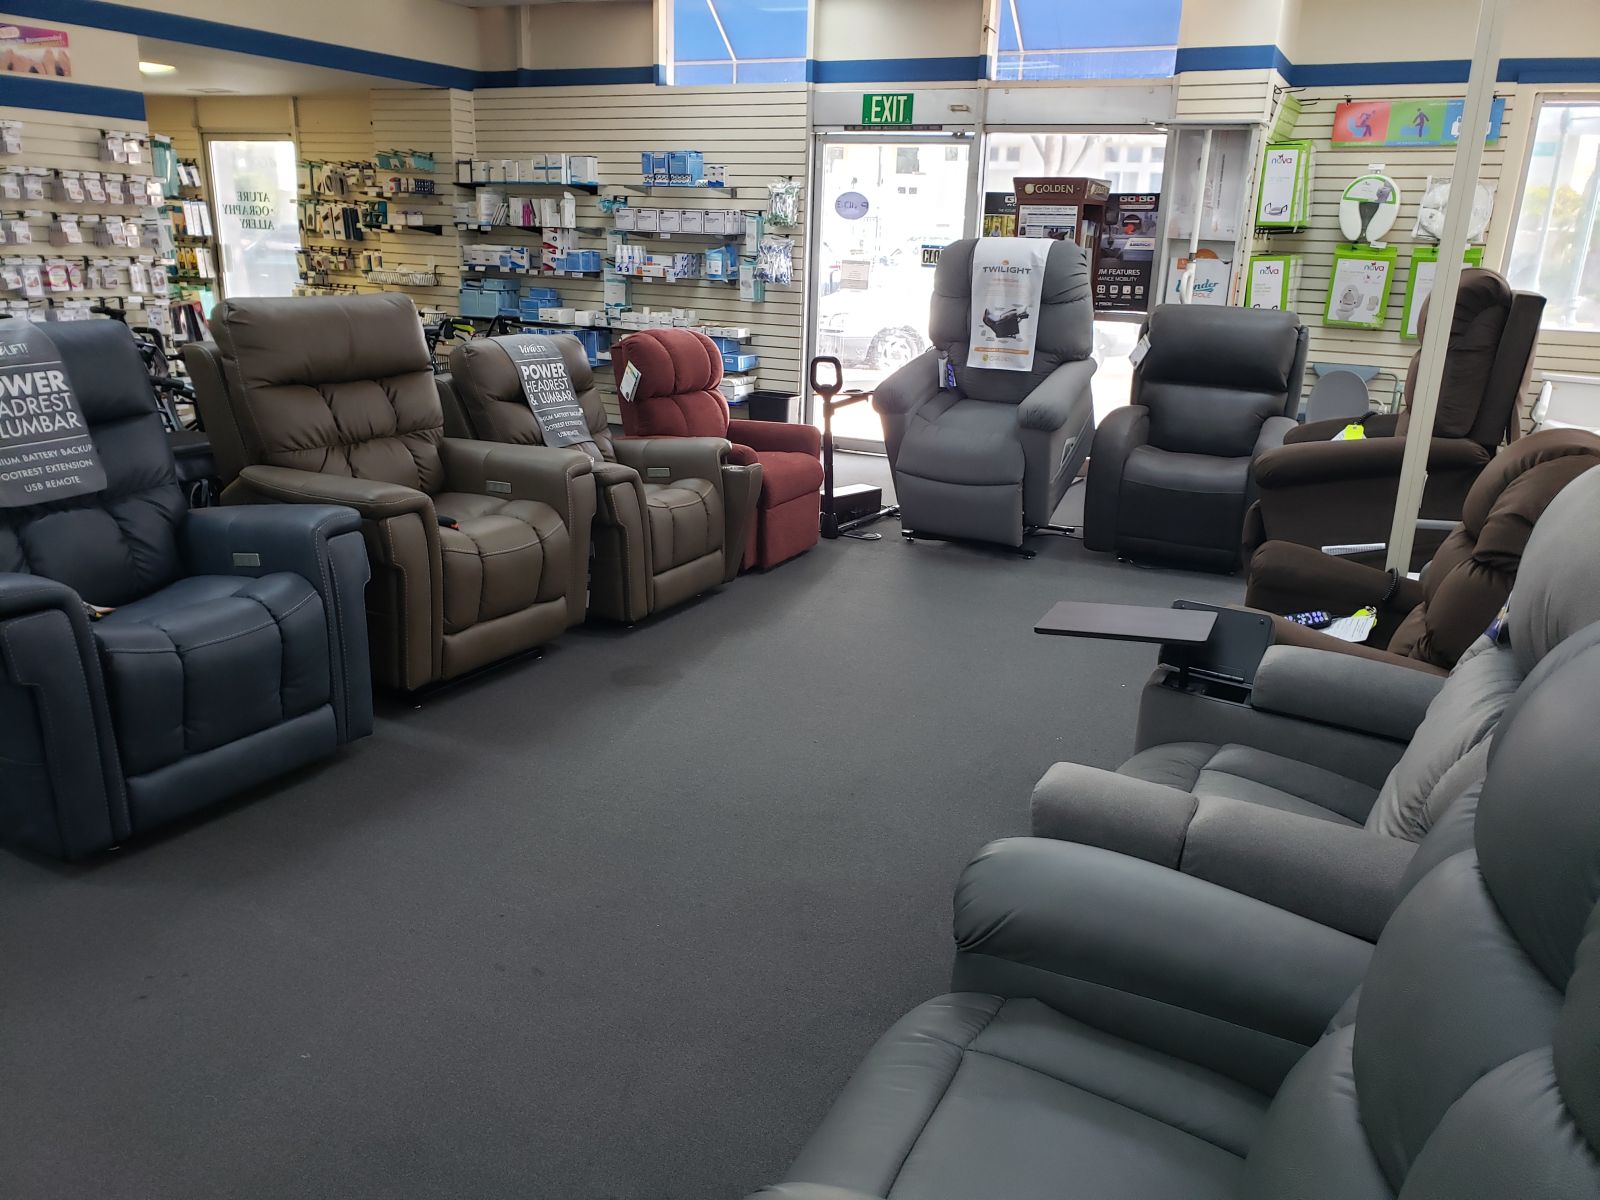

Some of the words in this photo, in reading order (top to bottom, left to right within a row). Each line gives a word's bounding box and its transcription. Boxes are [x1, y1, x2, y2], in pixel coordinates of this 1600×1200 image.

[871, 95, 908, 123] EXIT
[1035, 184, 1074, 194] GOLDEN
[922, 249, 943, 264] CLO
[982, 266, 1032, 275] TWILIGHT
[1108, 268, 1141, 276] FEATURES
[1260, 267, 1279, 275] nova
[1364, 263, 1384, 272] nova
[520, 362, 567, 380] POWER
[0, 370, 70, 398] WER
[525, 378, 569, 393] HEADREST
[529, 394, 539, 406] &
[539, 390, 575, 404] LUMBAR
[0, 411, 82, 438] LUMBAR
[22, 449, 58, 463] BATTERY
[60, 444, 92, 456] BACKUP
[0, 466, 43, 481] OOTREST
[45, 458, 94, 473] EXTENSION
[24, 481, 44, 493] USB
[45, 475, 81, 489] REMOTE
